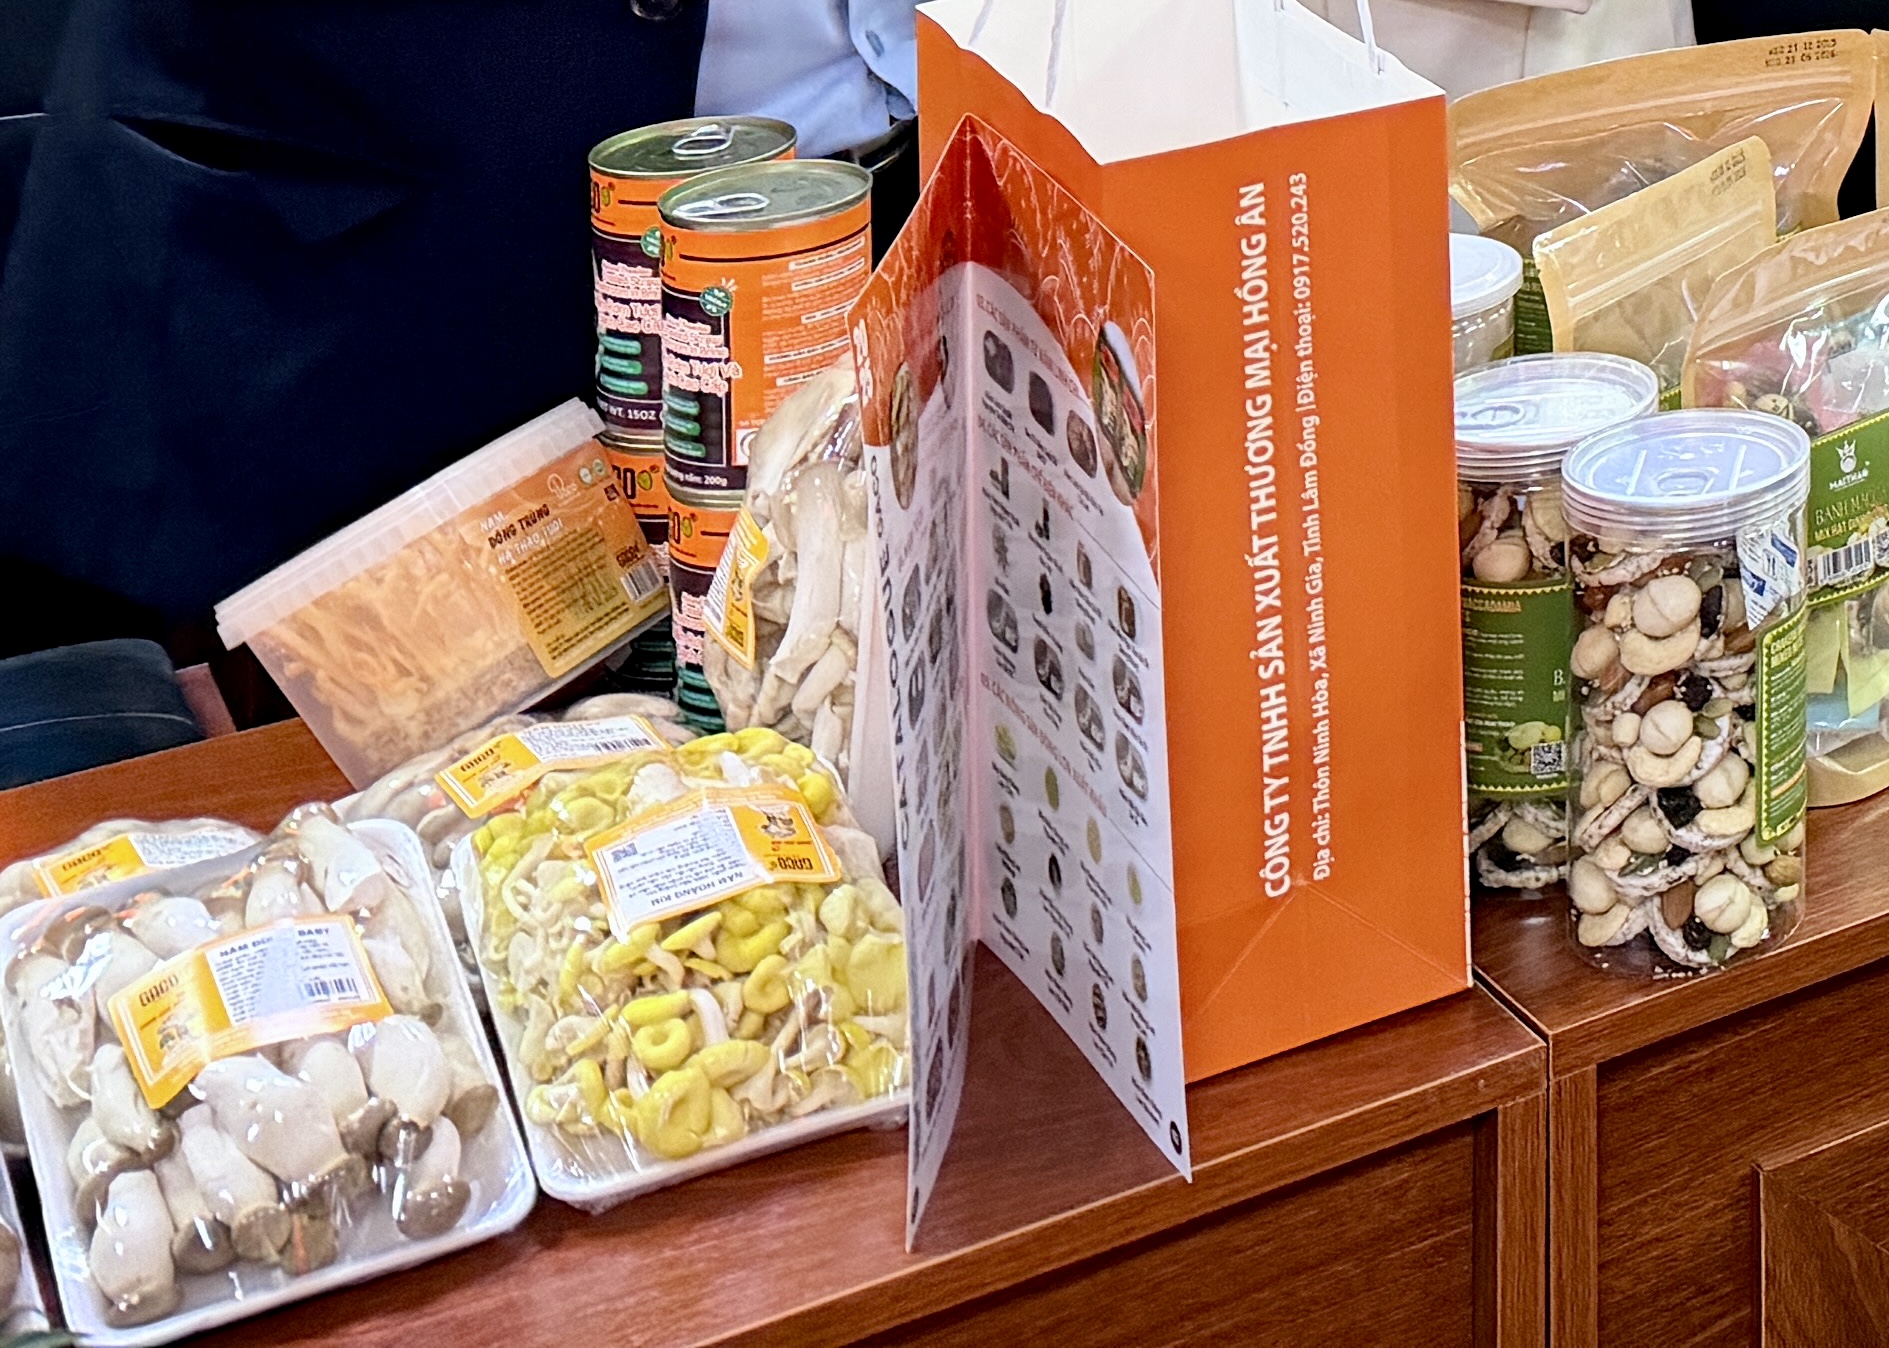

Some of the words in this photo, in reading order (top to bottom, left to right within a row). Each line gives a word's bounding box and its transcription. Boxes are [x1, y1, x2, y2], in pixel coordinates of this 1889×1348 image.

[1235, 182, 1267, 226] ÂN
[1290, 172, 1312, 299] 0917.520.243
[1295, 302, 1316, 357] thoại:
[1244, 329, 1278, 389] MẠI
[704, 474, 728, 487] 200g
[1244, 395, 1277, 530] THƯƠNG
[868, 454, 885, 540] GACO
[1300, 470, 1320, 510] Lâm
[1301, 514, 1322, 556] Tỉnh
[1244, 534, 1282, 612] XUẤT
[1304, 557, 1324, 594] Gia,
[1306, 598, 1326, 643] Ninh
[1249, 615, 1285, 679] SẢN
[1308, 647, 1327, 671] Xã
[878, 550, 909, 849] CATALOGUE
[1260, 683, 1290, 772] TNHH
[1311, 719, 1330, 764] Ninh
[1262, 776, 1290, 813] TY
[1311, 767, 1330, 813] Thôn
[1259, 812, 1291, 898] CÔNG
[297, 926, 330, 938] BABY
